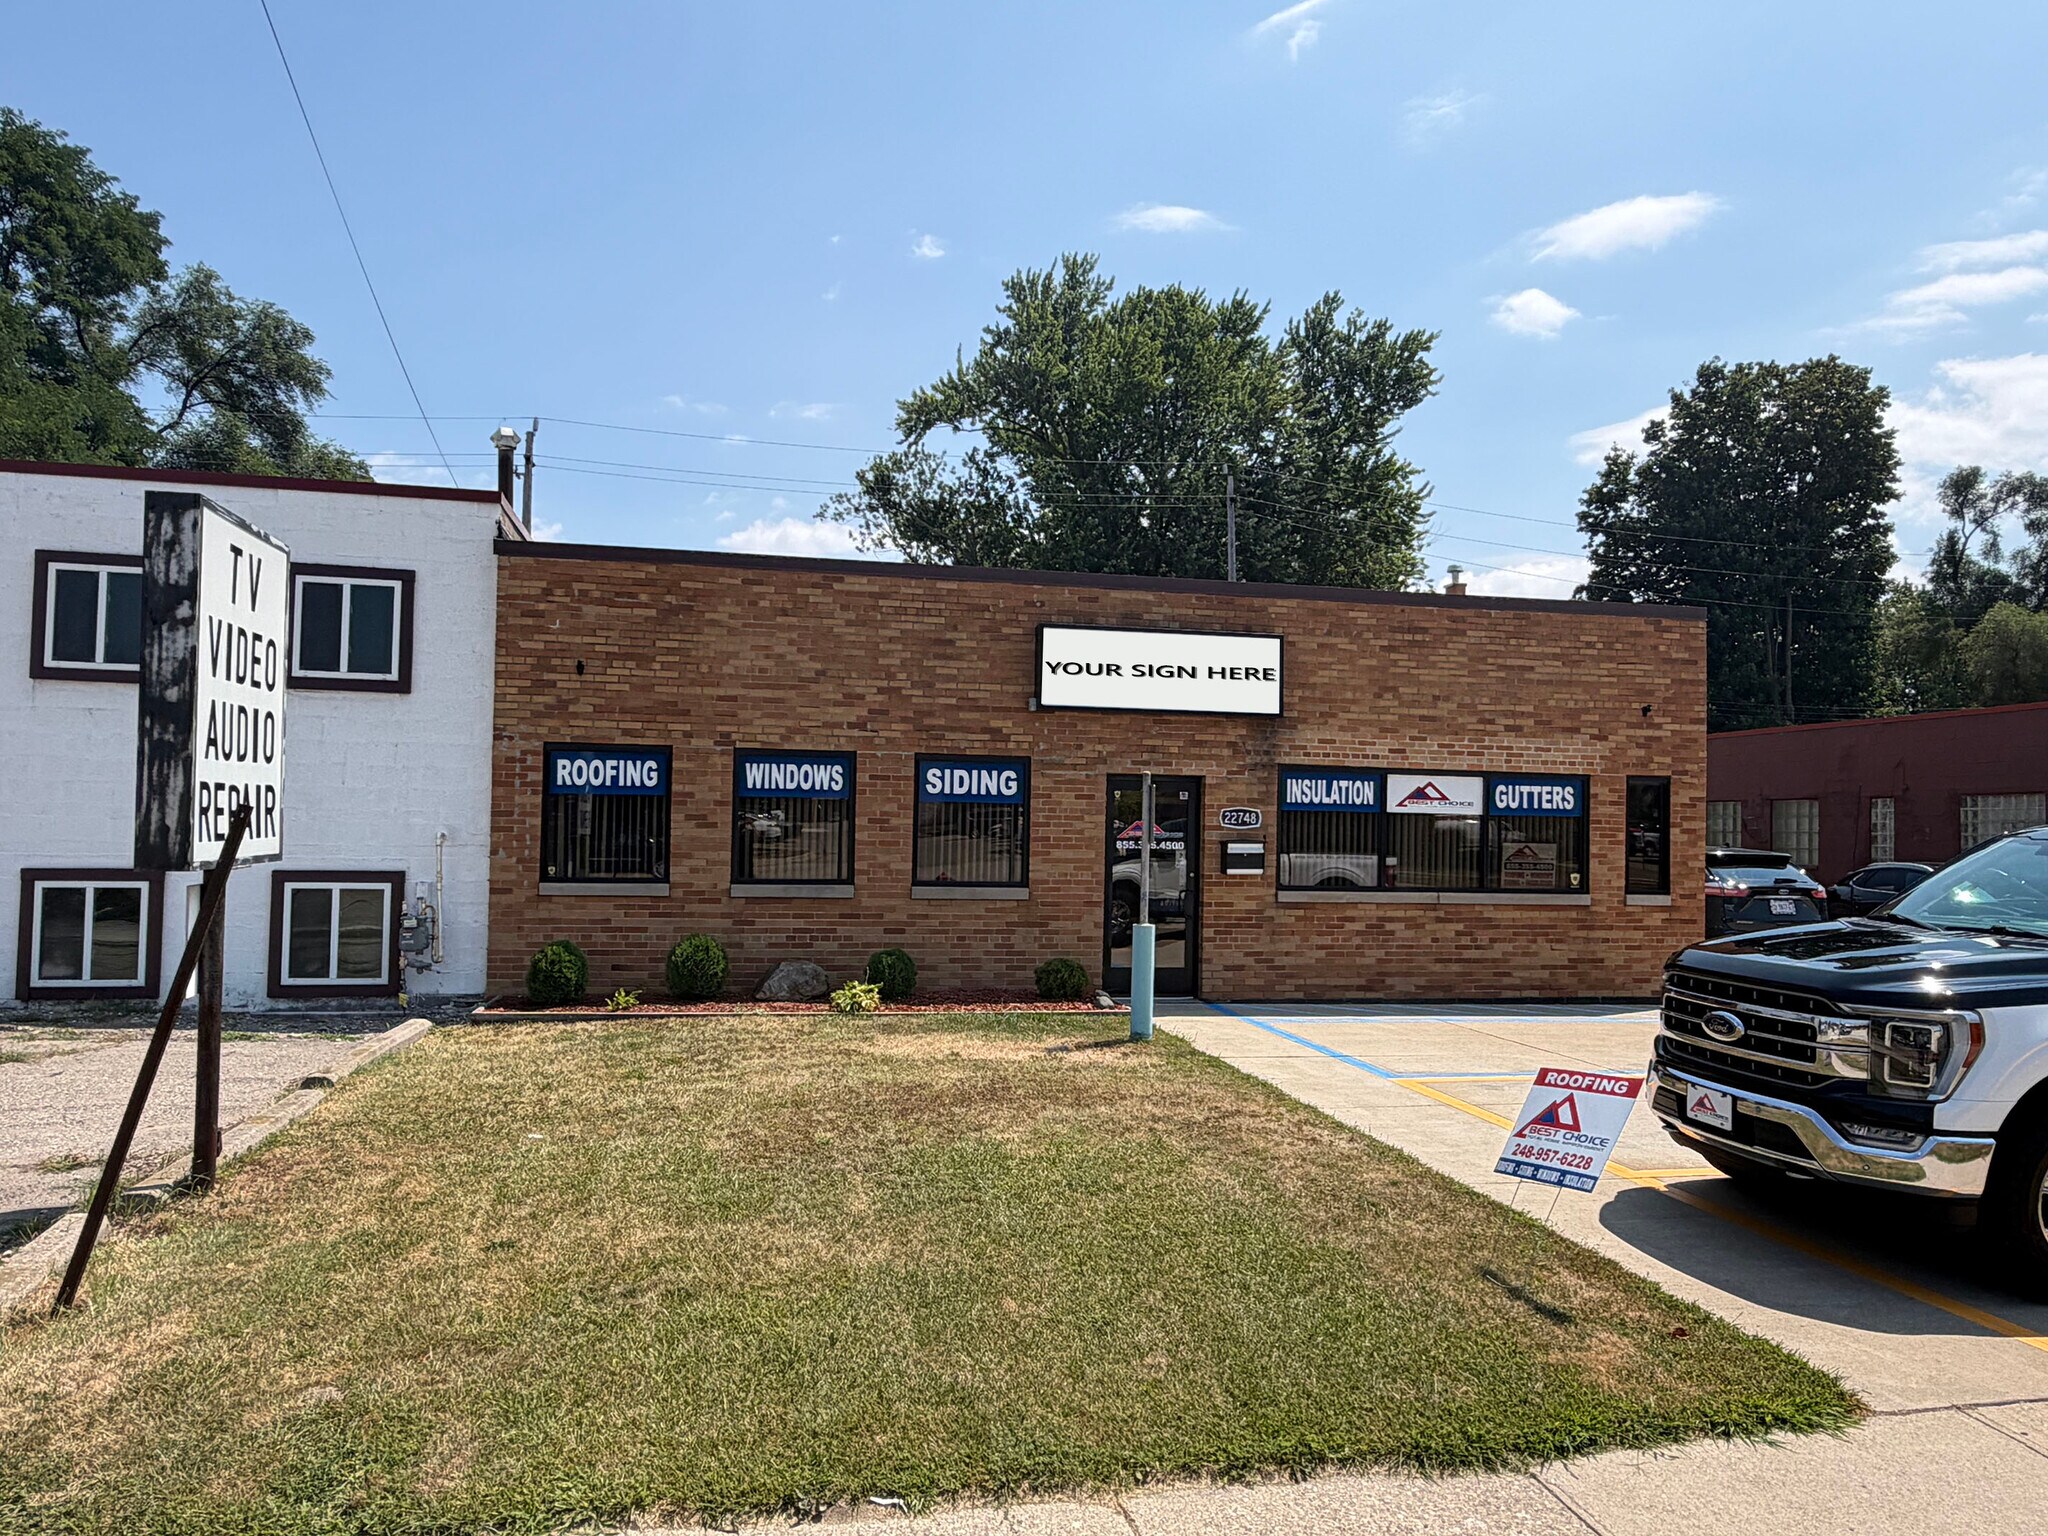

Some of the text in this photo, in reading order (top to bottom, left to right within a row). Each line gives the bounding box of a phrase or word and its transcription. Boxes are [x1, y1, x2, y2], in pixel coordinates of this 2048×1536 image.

[208, 615, 277, 692] VIDEO
[1045, 661, 1277, 681] YOUR SIGN HERE
[204, 699, 275, 765] AUDIO
[556, 758, 659, 788] ROOFING
[745, 763, 844, 791] WINDOWS
[925, 768, 1018, 796] SIDING
[1286, 778, 1375, 806] INSULATION
[1495, 785, 1575, 810] GUTTERS
[198, 781, 276, 843] REPAIR
[1224, 813, 1257, 825] 22748
[1708, 1018, 1728, 1033] Ford
[1544, 1072, 1629, 1094] ROOFING
[1529, 1126, 1611, 1148] BEST CHOICE
[1511, 1142, 1594, 1171] 248-957-6228
